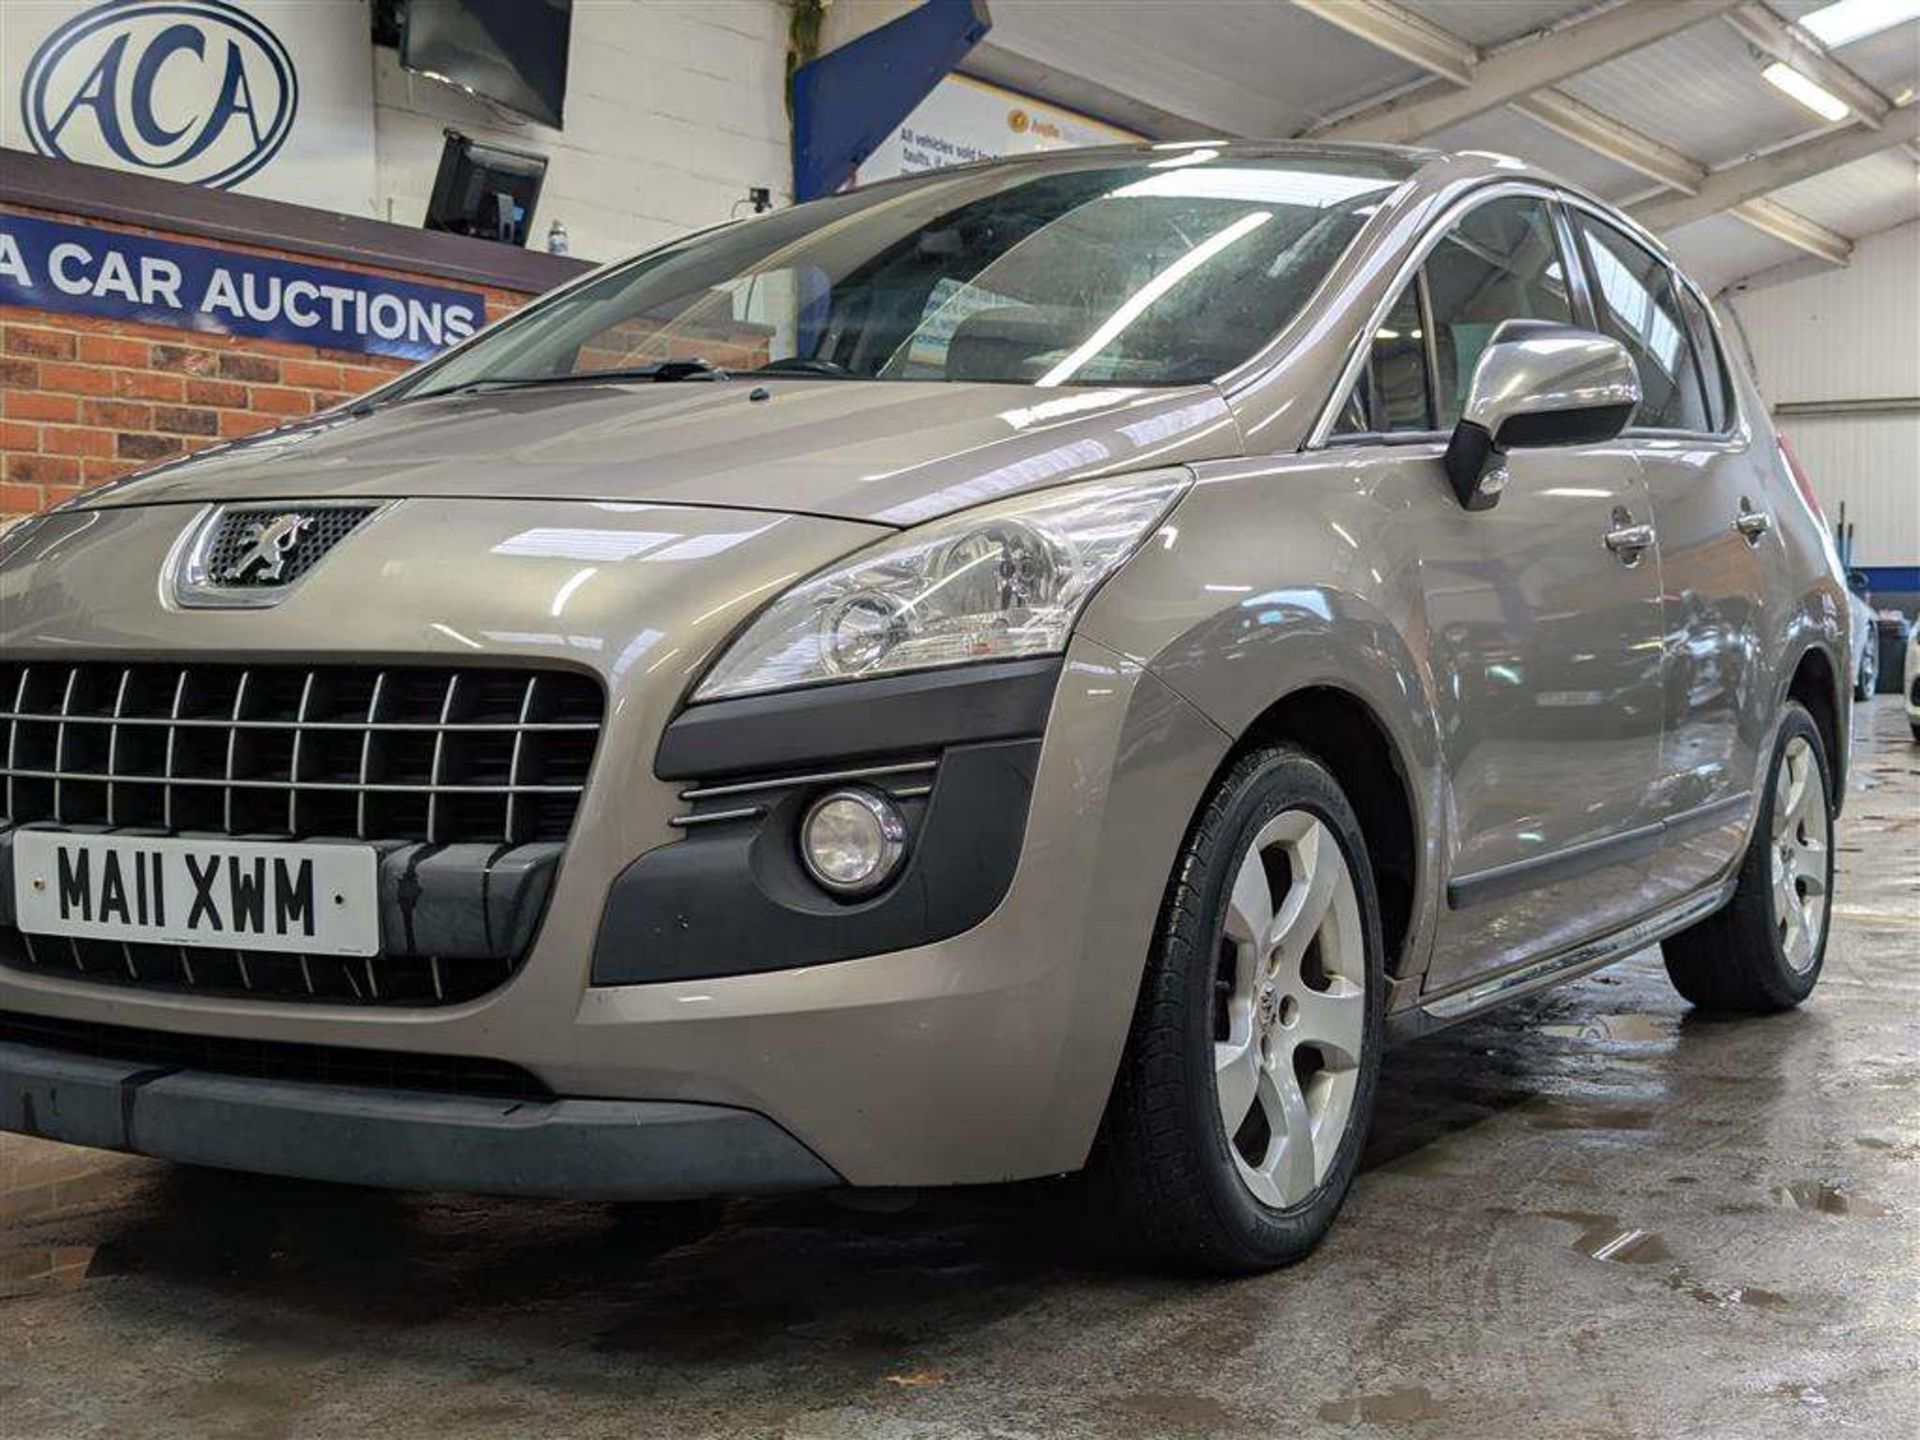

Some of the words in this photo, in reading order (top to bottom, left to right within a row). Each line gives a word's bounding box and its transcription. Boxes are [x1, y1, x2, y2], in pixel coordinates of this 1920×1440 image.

[50, 23, 264, 168] ACA
[915, 133, 954, 156] vehicles
[48, 242, 182, 308] CAR
[201, 268, 476, 348] AUCTIONS
[57, 846, 166, 927] MA11
[184, 853, 316, 936] XWM
